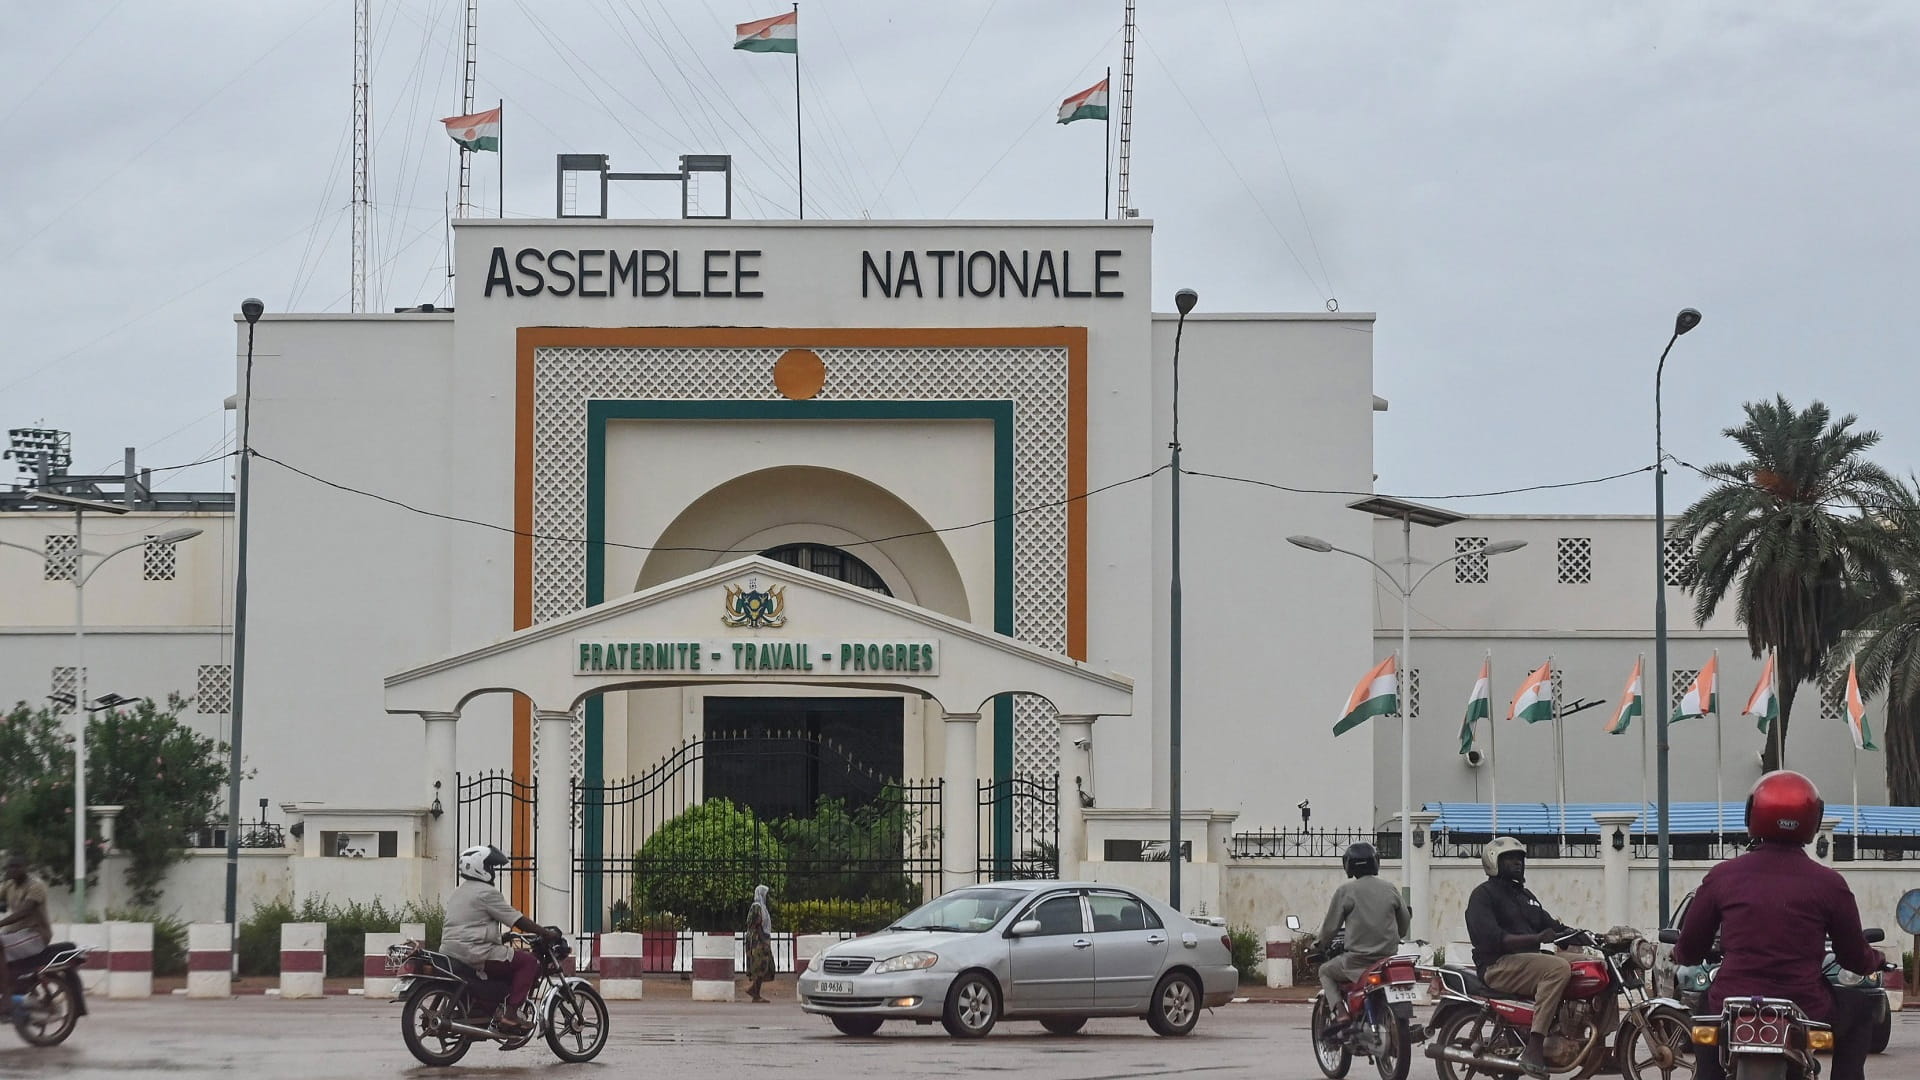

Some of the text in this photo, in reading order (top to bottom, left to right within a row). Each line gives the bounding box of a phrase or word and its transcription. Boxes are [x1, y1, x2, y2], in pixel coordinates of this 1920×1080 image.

[484, 247, 1124, 298] ASSEMBLEE NATIONALE
[580, 643, 701, 671] FRATERNITE
[732, 643, 813, 671] TRAVAIL
[840, 643, 933, 671] PROGRES
